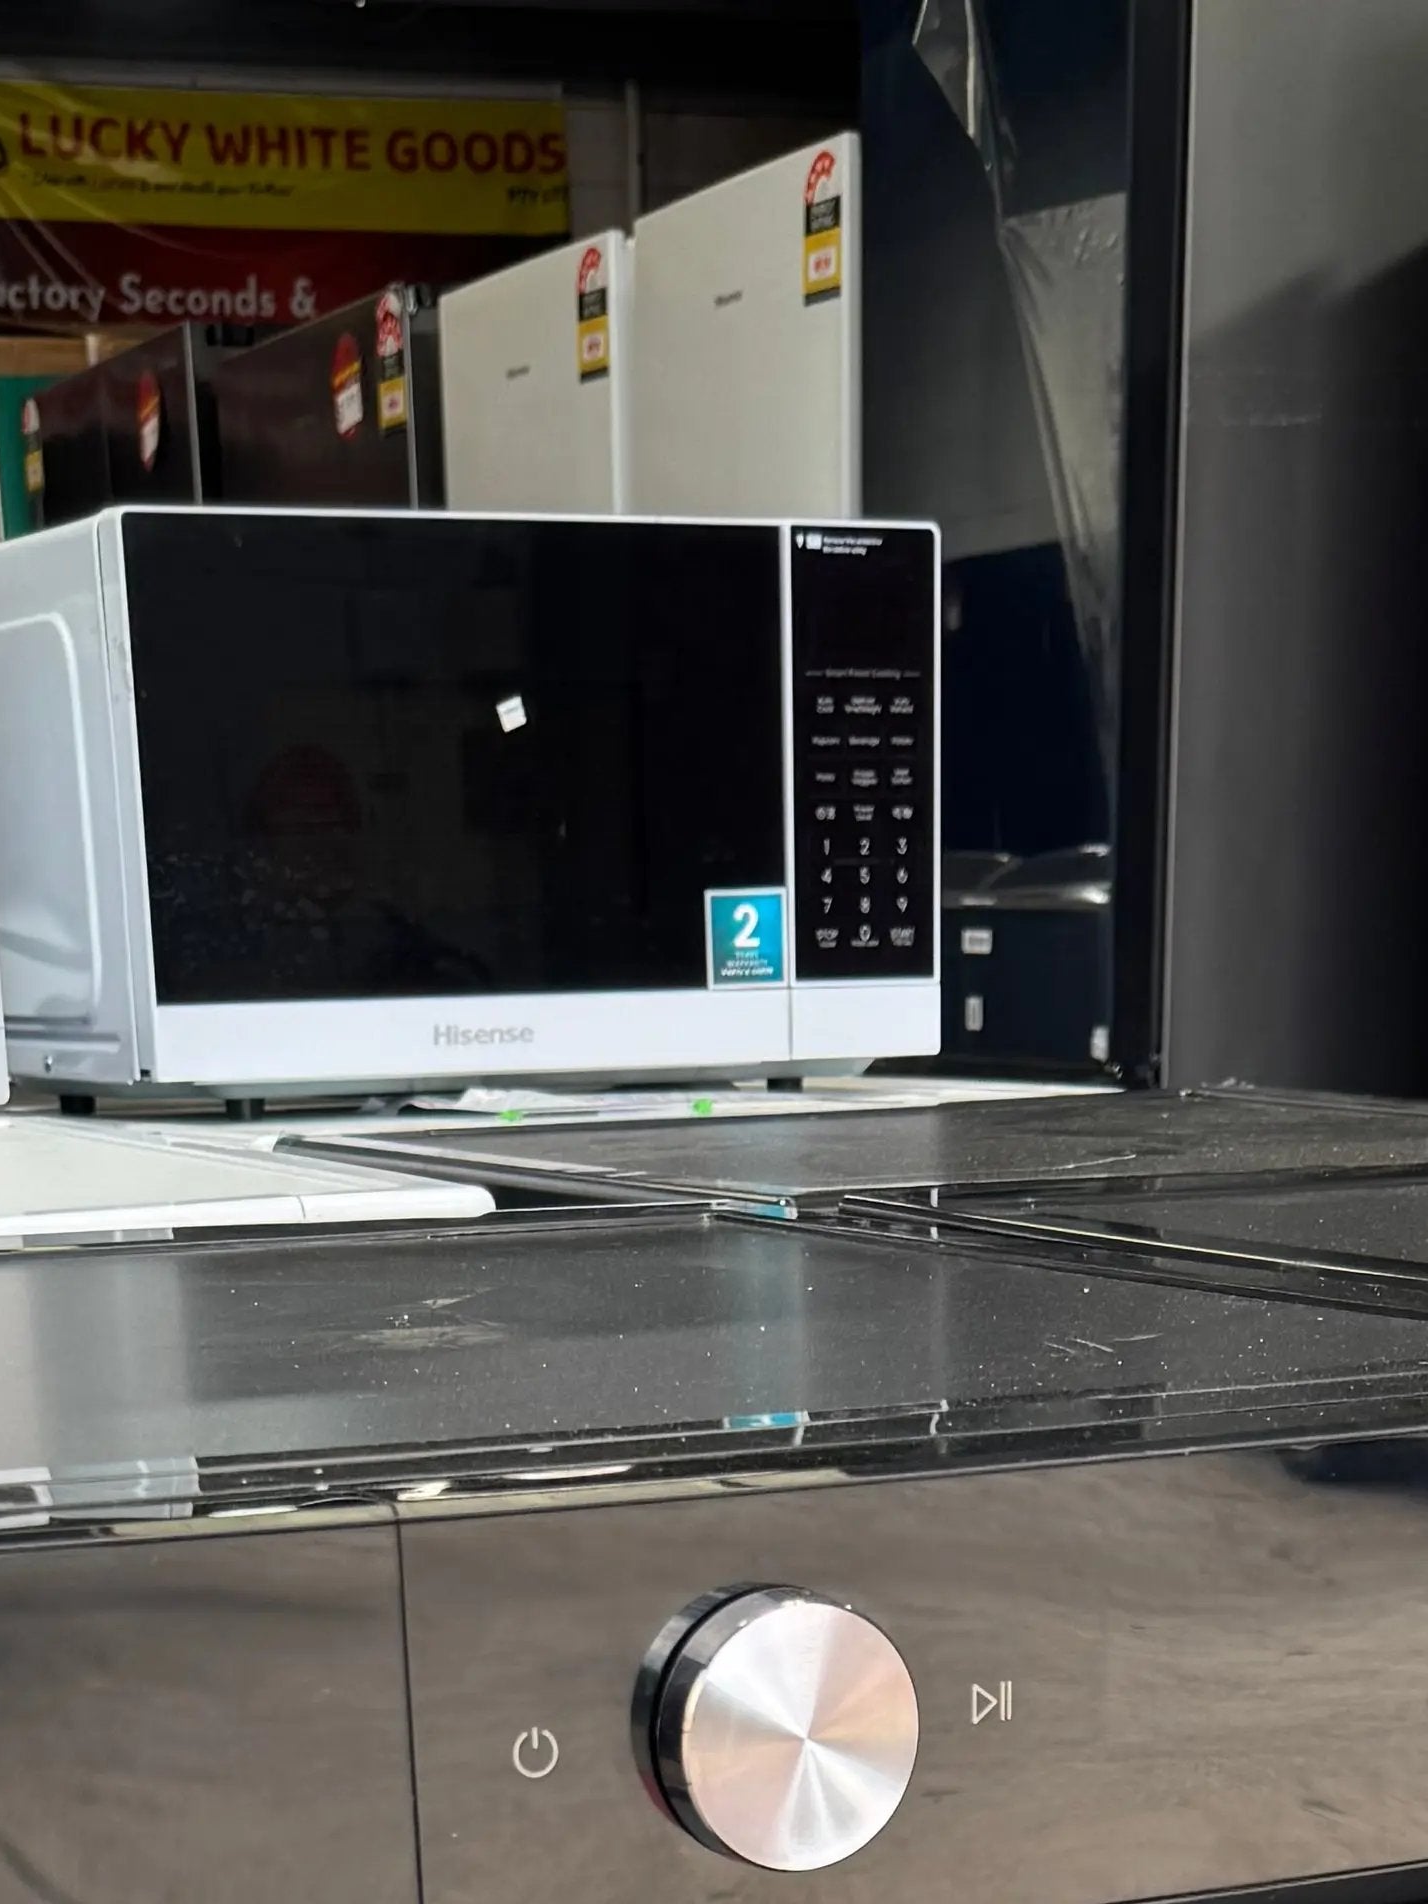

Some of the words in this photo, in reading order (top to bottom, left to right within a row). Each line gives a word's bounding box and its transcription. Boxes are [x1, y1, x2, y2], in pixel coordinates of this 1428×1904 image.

[19, 113, 190, 164] LUCKY
[205, 122, 370, 169] WHITE
[386, 131, 566, 175] GOODS
[119, 273, 273, 317] Seconds
[290, 277, 316, 320] &
[822, 837, 831, 856] 1
[860, 837, 871, 856] 2
[897, 837, 908, 856] 3
[822, 867, 831, 884] 4
[860, 867, 871, 884] 5
[897, 867, 908, 884] 6
[822, 897, 831, 914] 7
[860, 897, 871, 914] 8
[897, 897, 908, 914] 9
[733, 903, 760, 948] 2
[433, 1024, 534, 1046] Hisense
